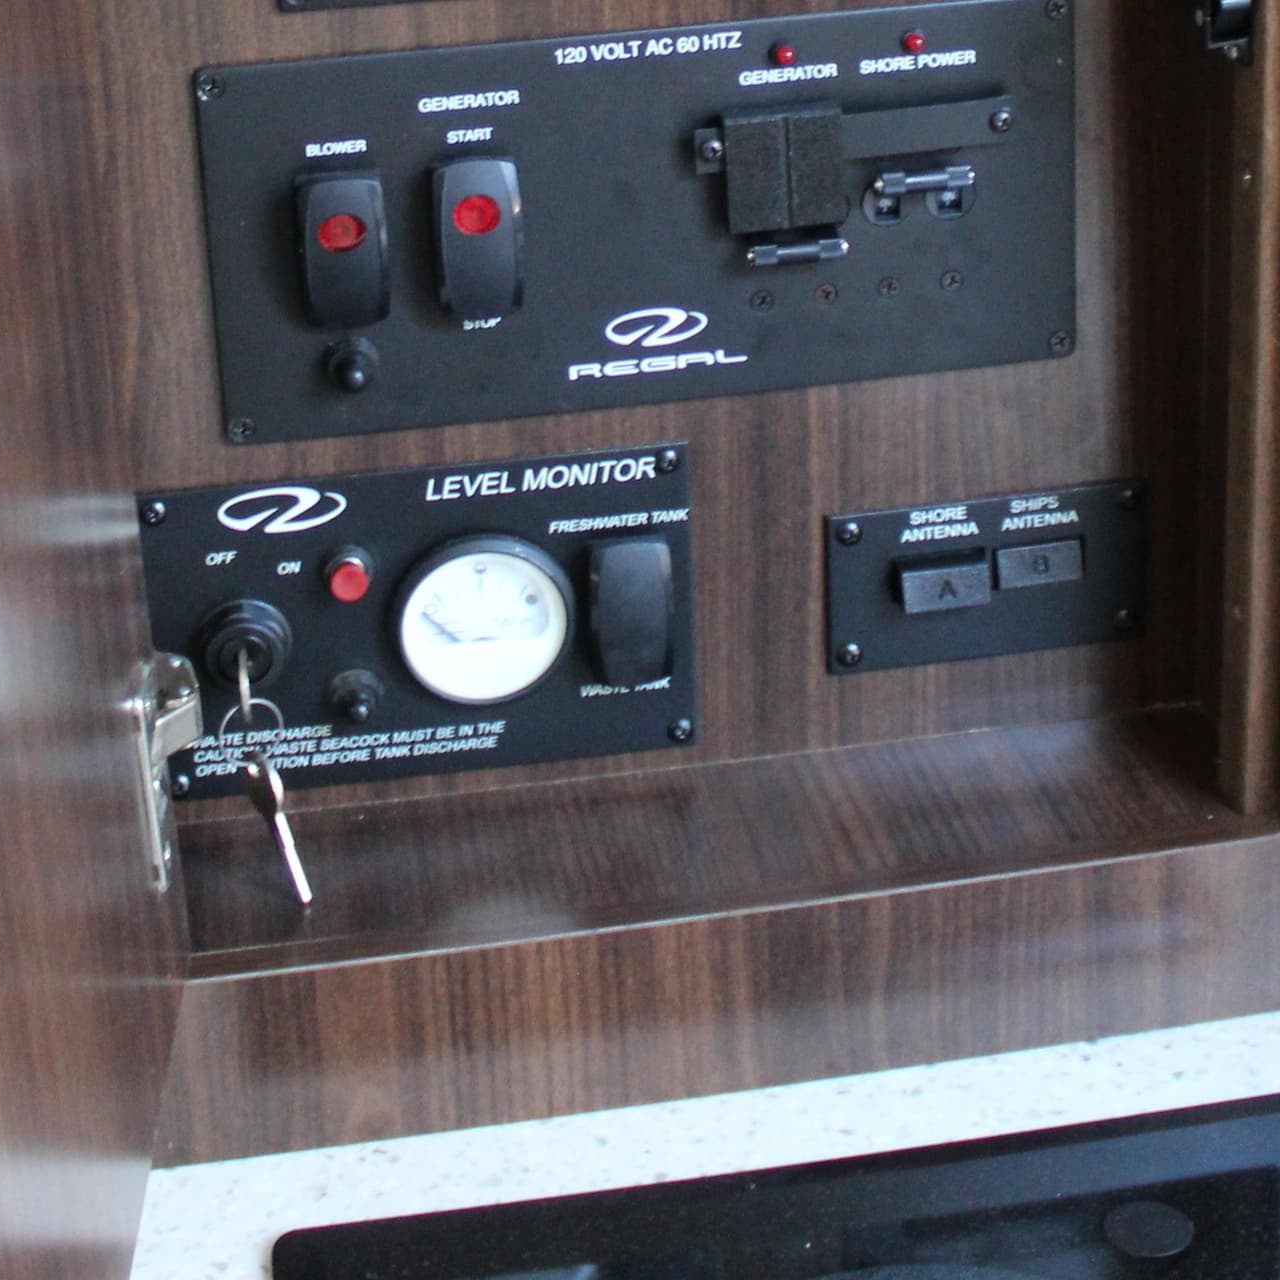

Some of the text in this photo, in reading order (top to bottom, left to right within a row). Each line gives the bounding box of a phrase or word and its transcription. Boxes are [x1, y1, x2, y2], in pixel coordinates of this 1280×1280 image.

[554, 31, 742, 64] 120 VOLT AC 60 HTZ
[860, 50, 976, 75] SHORE POWER
[739, 63, 838, 86] GENERATOR
[418, 90, 520, 112] GENERATOR
[447, 127, 493, 144] START
[306, 139, 367, 157] BLOWER
[568, 349, 748, 381] REGAL
[426, 456, 656, 501] LEVEL MONITOR
[910, 505, 968, 525] SHORE
[1009, 495, 1060, 514] SHIPS
[549, 507, 689, 534] FRESHWATER TANK
[1001, 510, 1079, 532] ANTENNA
[901, 521, 979, 543] ANTENNA
[205, 550, 237, 566] OFF
[277, 561, 302, 575] ON
[937, 579, 958, 601] A
[246, 724, 333, 745] DISCHARGE
[320, 732, 391, 752] SEACOCK
[392, 727, 434, 744] MUST
[436, 725, 456, 740] BE
[459, 723, 474, 737] IN
[477, 720, 506, 736] THE
[311, 747, 371, 767] BEFORE
[374, 743, 410, 761] TANK
[413, 735, 498, 757] DISCHARGE
